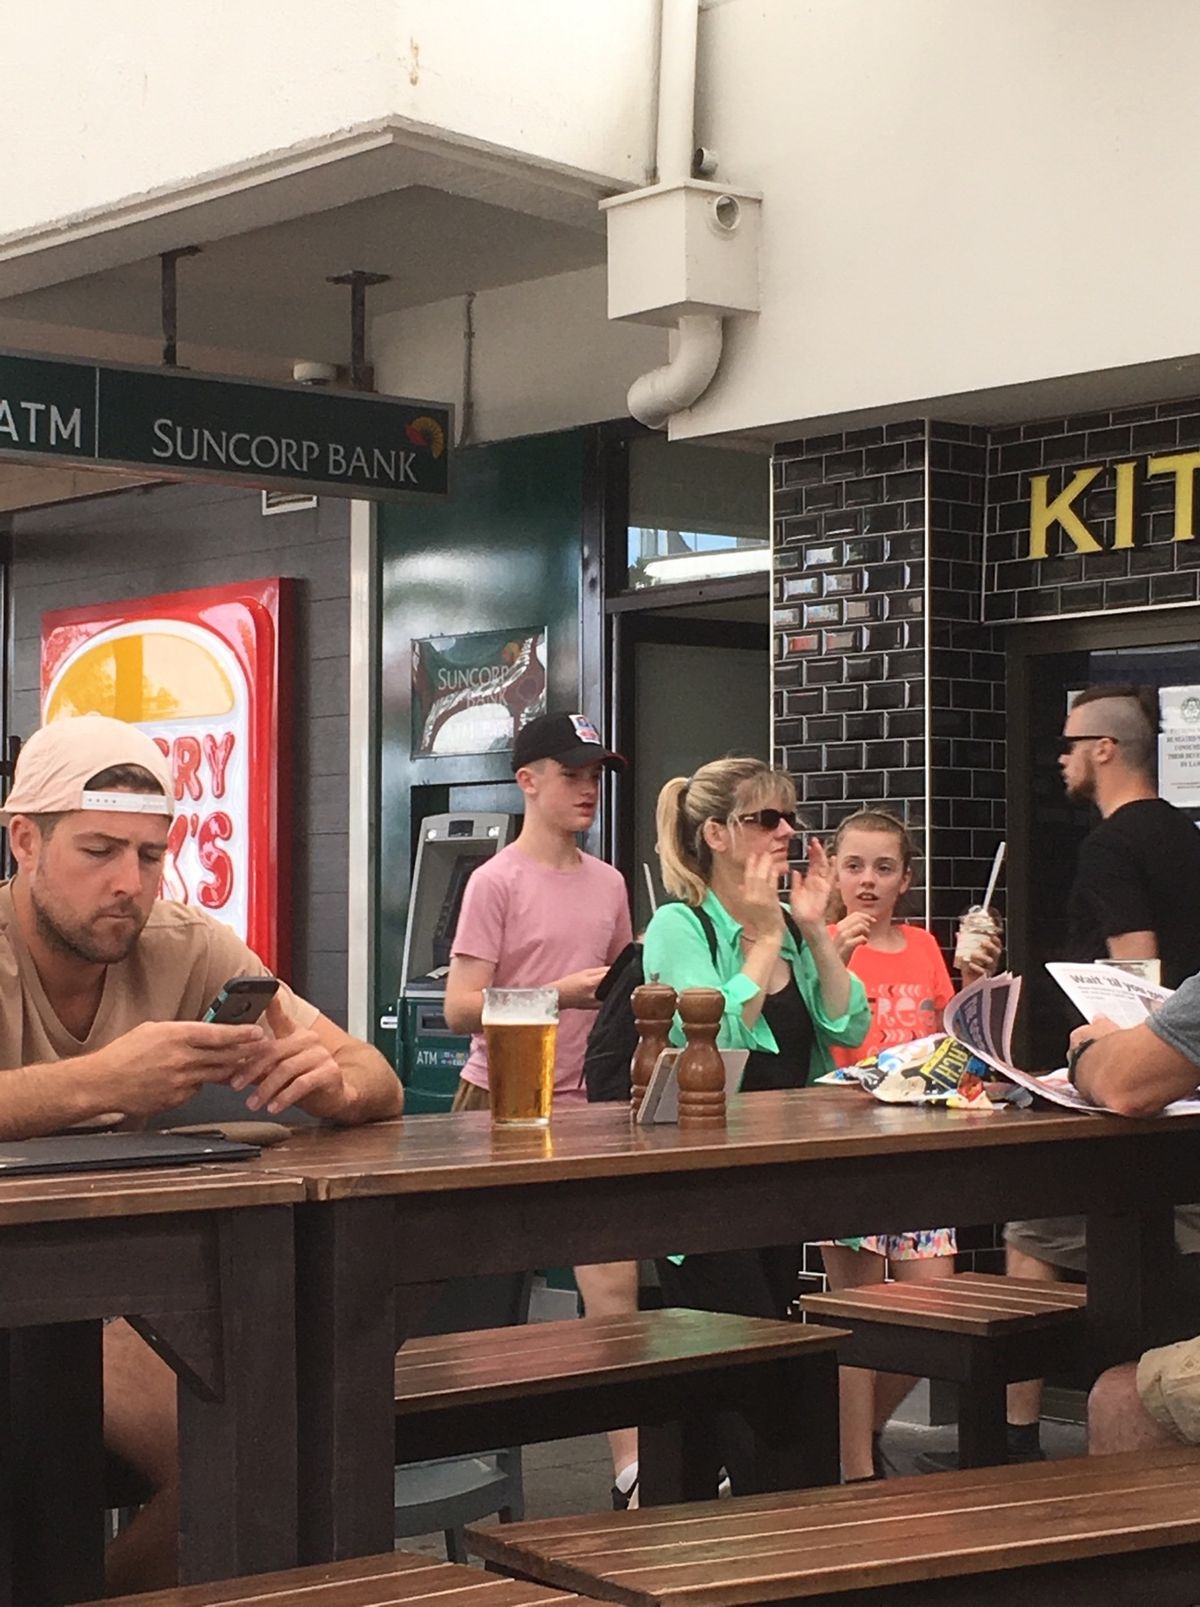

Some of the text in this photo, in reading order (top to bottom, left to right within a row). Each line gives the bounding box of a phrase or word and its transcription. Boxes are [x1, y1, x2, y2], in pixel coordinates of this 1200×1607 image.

[0, 399, 82, 448] ATM
[152, 418, 419, 484] SUNCORP BANK
[1026, 450, 1200, 560] KIT
[437, 664, 510, 691] SUNCORP
[416, 1050, 438, 1065] ATM
